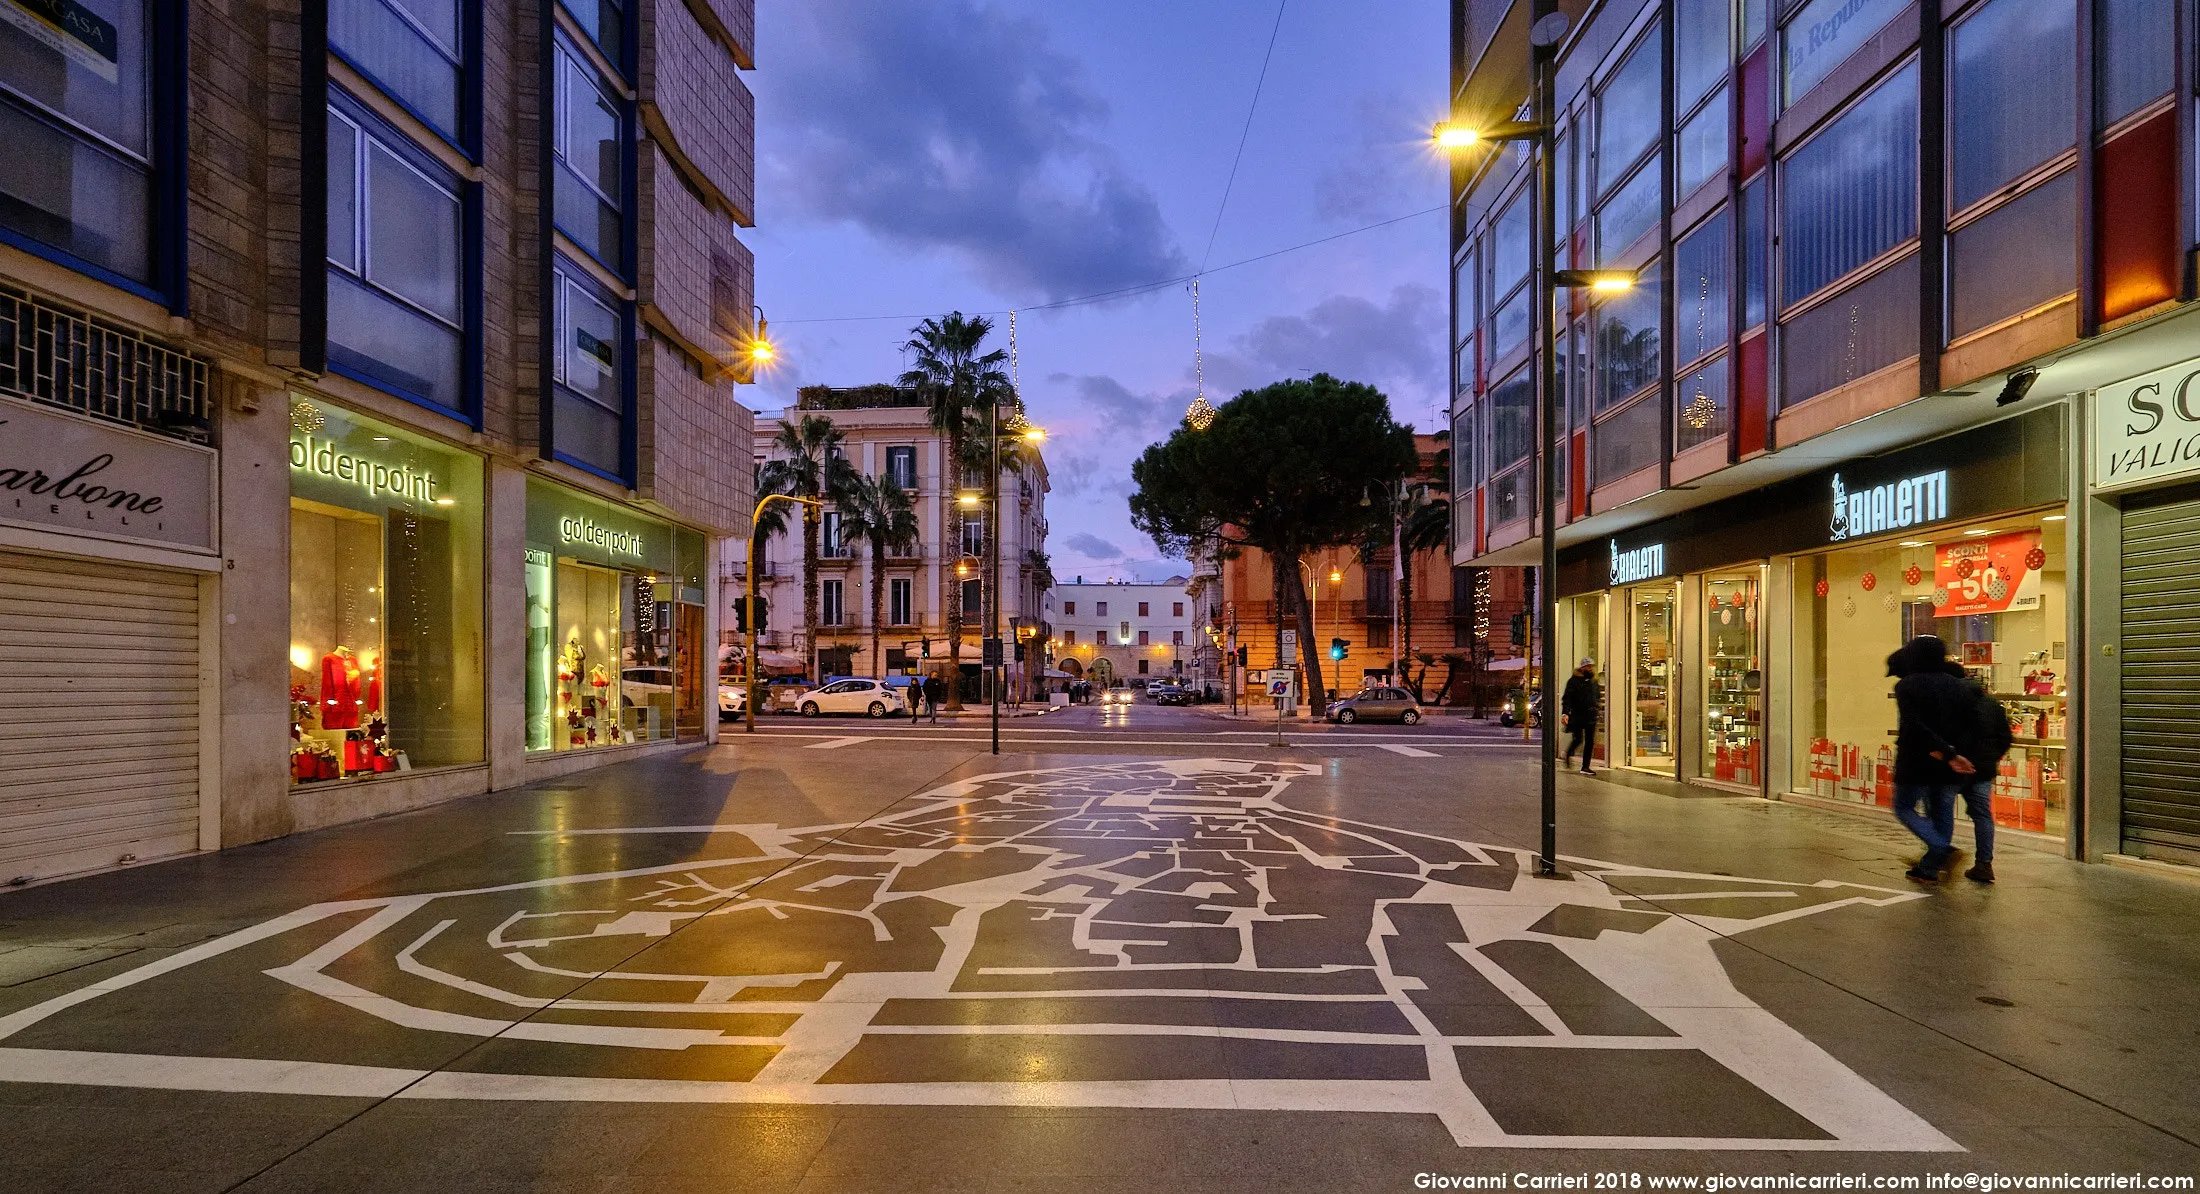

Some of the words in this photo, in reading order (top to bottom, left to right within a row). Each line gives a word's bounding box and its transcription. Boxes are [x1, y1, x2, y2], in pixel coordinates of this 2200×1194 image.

[561, 516, 644, 556] goldenpoint
[1947, 543, 1989, 559] SCONTI
[227, 559, 235, 570] 3
[1193, 659, 1199, 667] P
